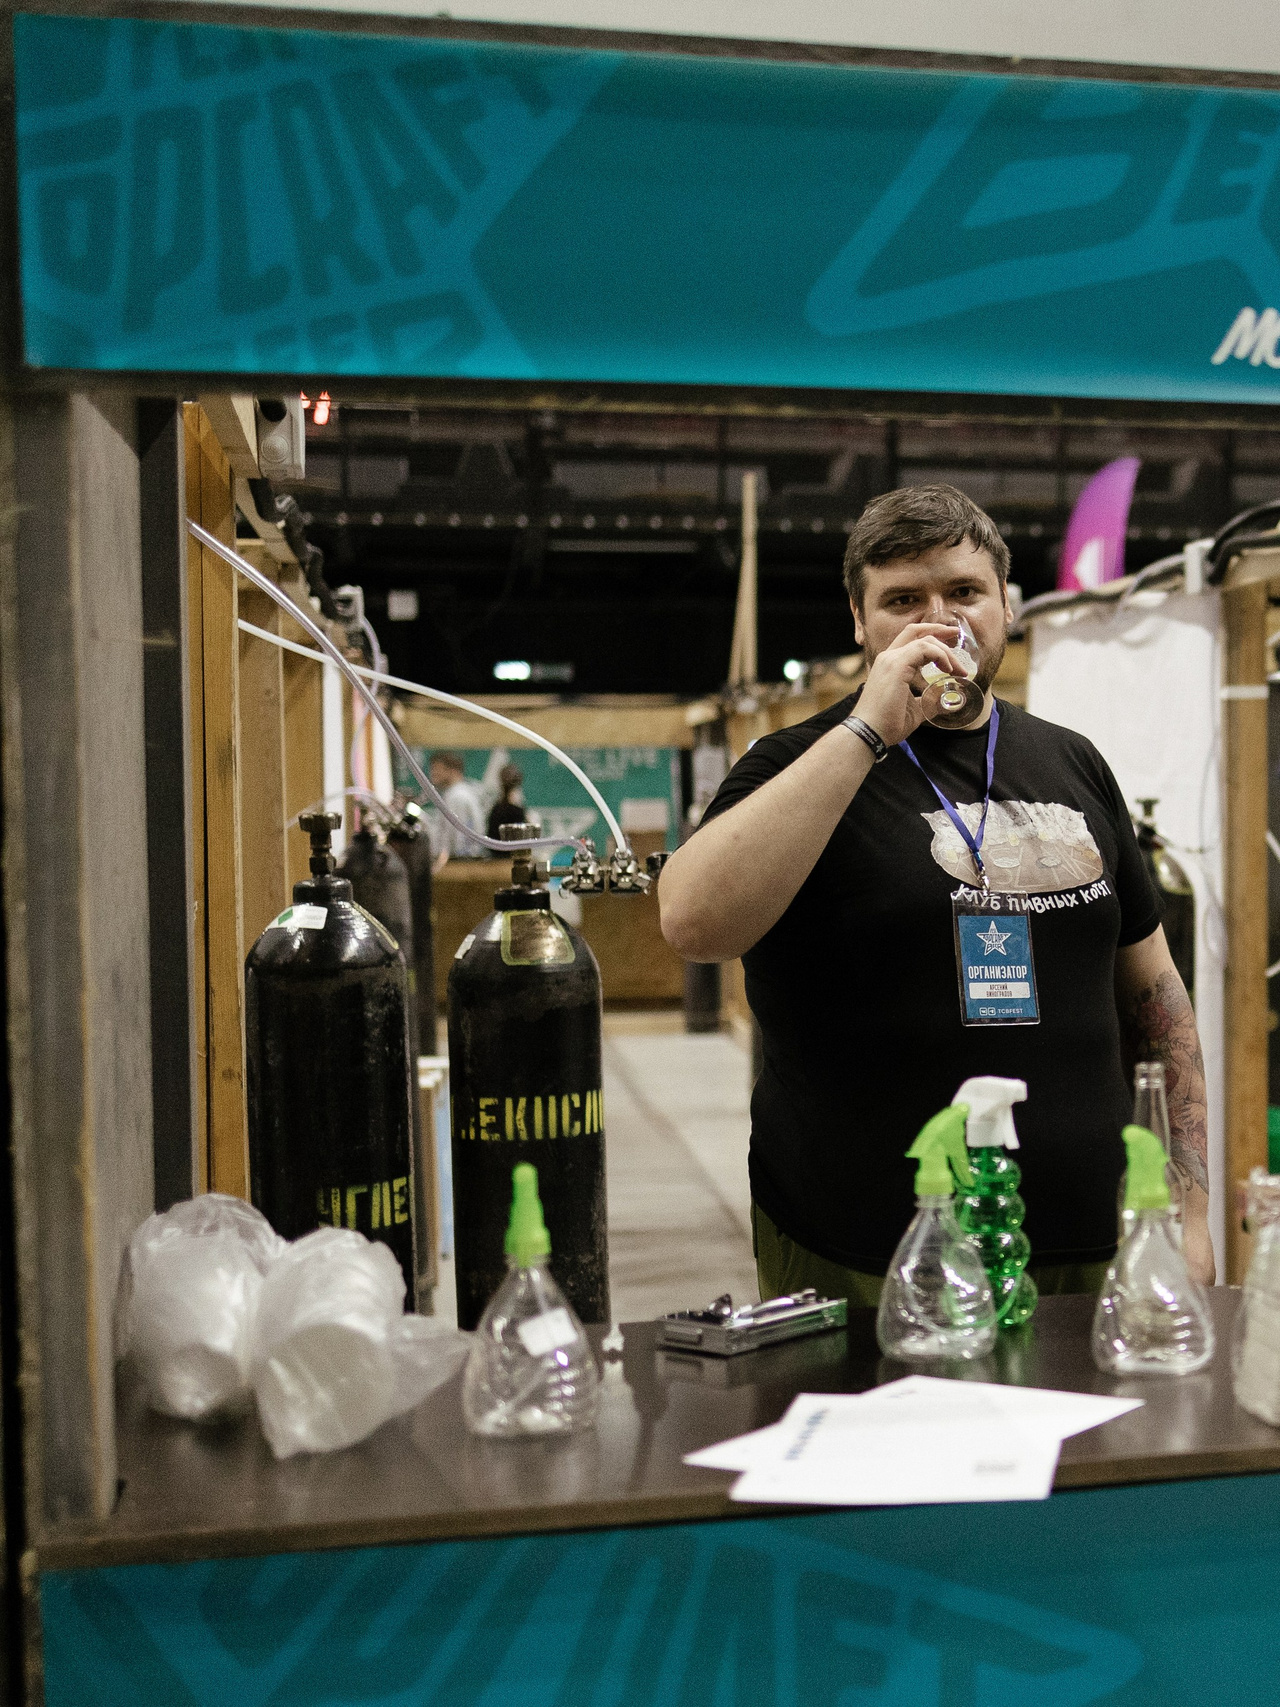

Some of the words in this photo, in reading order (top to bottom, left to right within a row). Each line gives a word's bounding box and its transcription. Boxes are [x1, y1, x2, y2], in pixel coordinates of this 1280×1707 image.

[1008, 894, 1079, 913] ПИВНЫХ
[1080, 880, 1111, 904] КОТЯТ
[968, 966, 1028, 979] ОРГАНИЗАТОР
